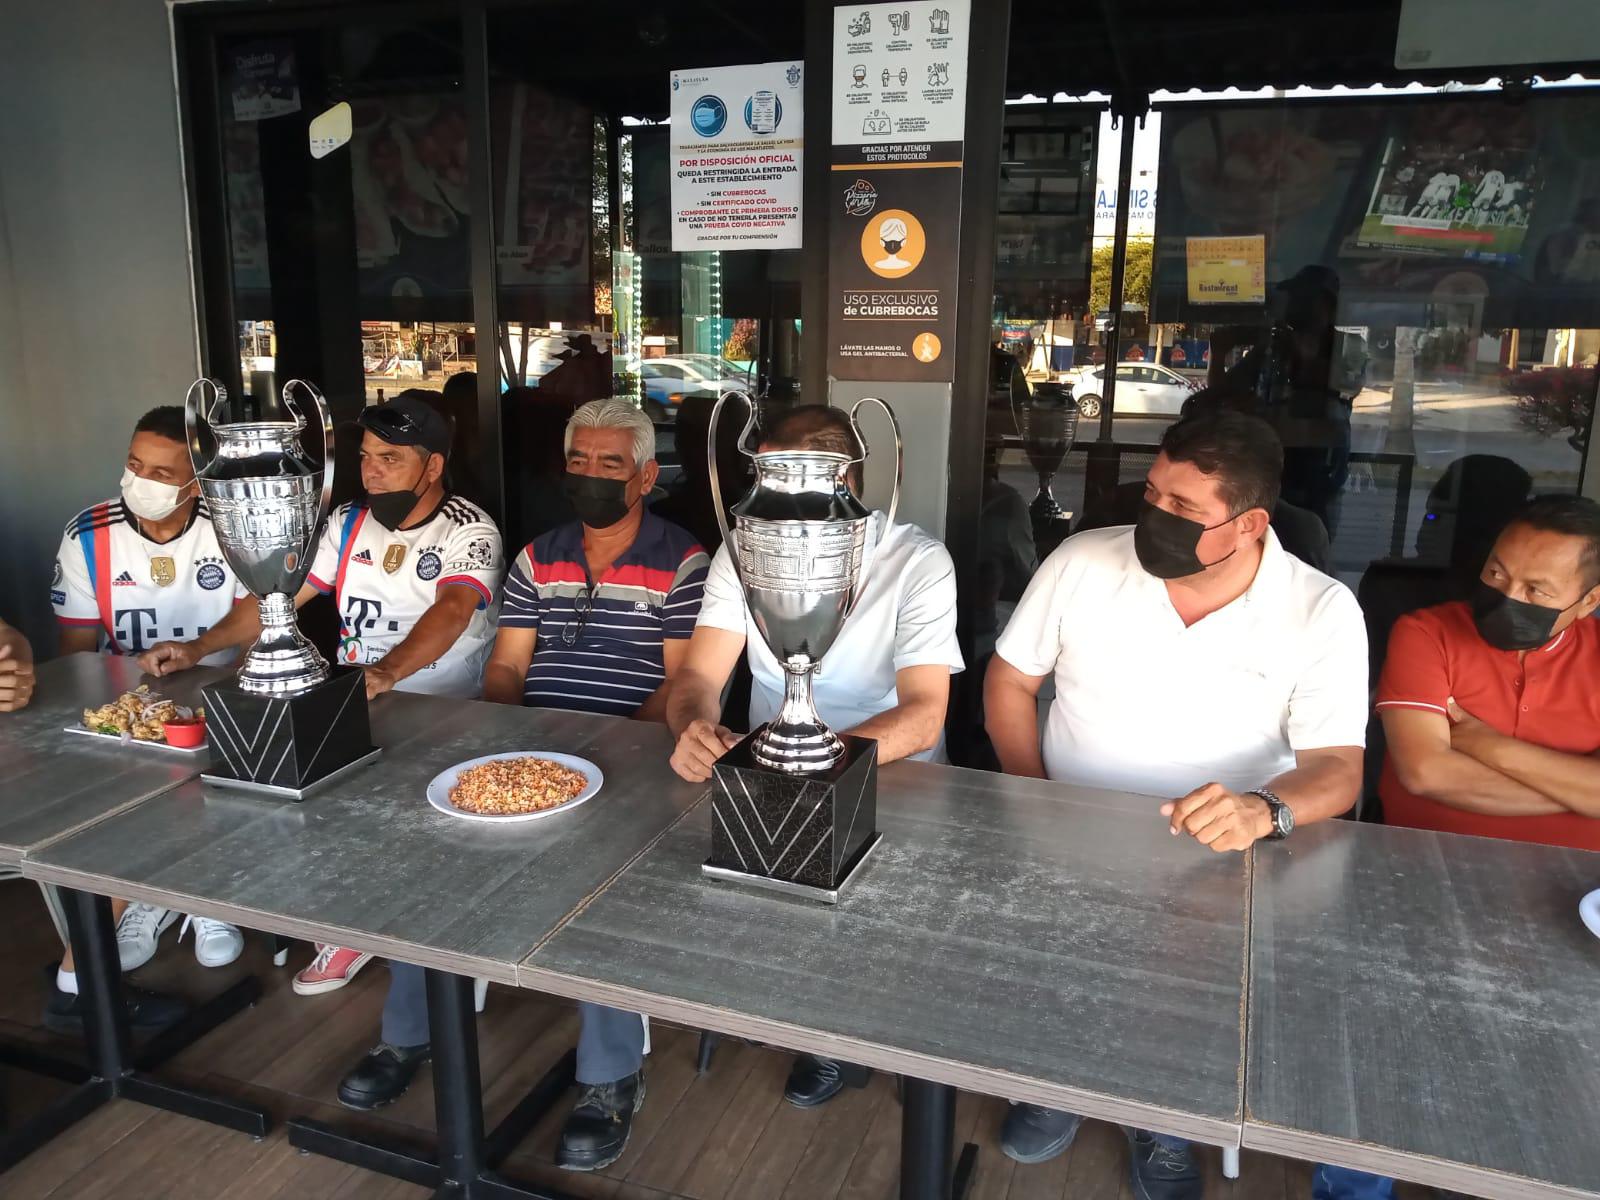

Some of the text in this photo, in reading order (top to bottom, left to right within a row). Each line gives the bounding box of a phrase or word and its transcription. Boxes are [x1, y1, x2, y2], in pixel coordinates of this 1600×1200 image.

[903, 144, 931, 152] ATENDER
[680, 154, 795, 167] POR DISPOSICIÓN OFICIAL
[887, 153, 928, 161] PROTOCOLOS
[677, 170, 701, 178] QUEDA
[703, 168, 749, 177] RESTRINGIDA
[699, 176, 716, 184] ESTE
[717, 174, 782, 182] ESTABLECIMIENTO
[843, 294, 938, 305] USO EXCLUSIVO
[844, 306, 938, 316] de CUBREBOCAS
